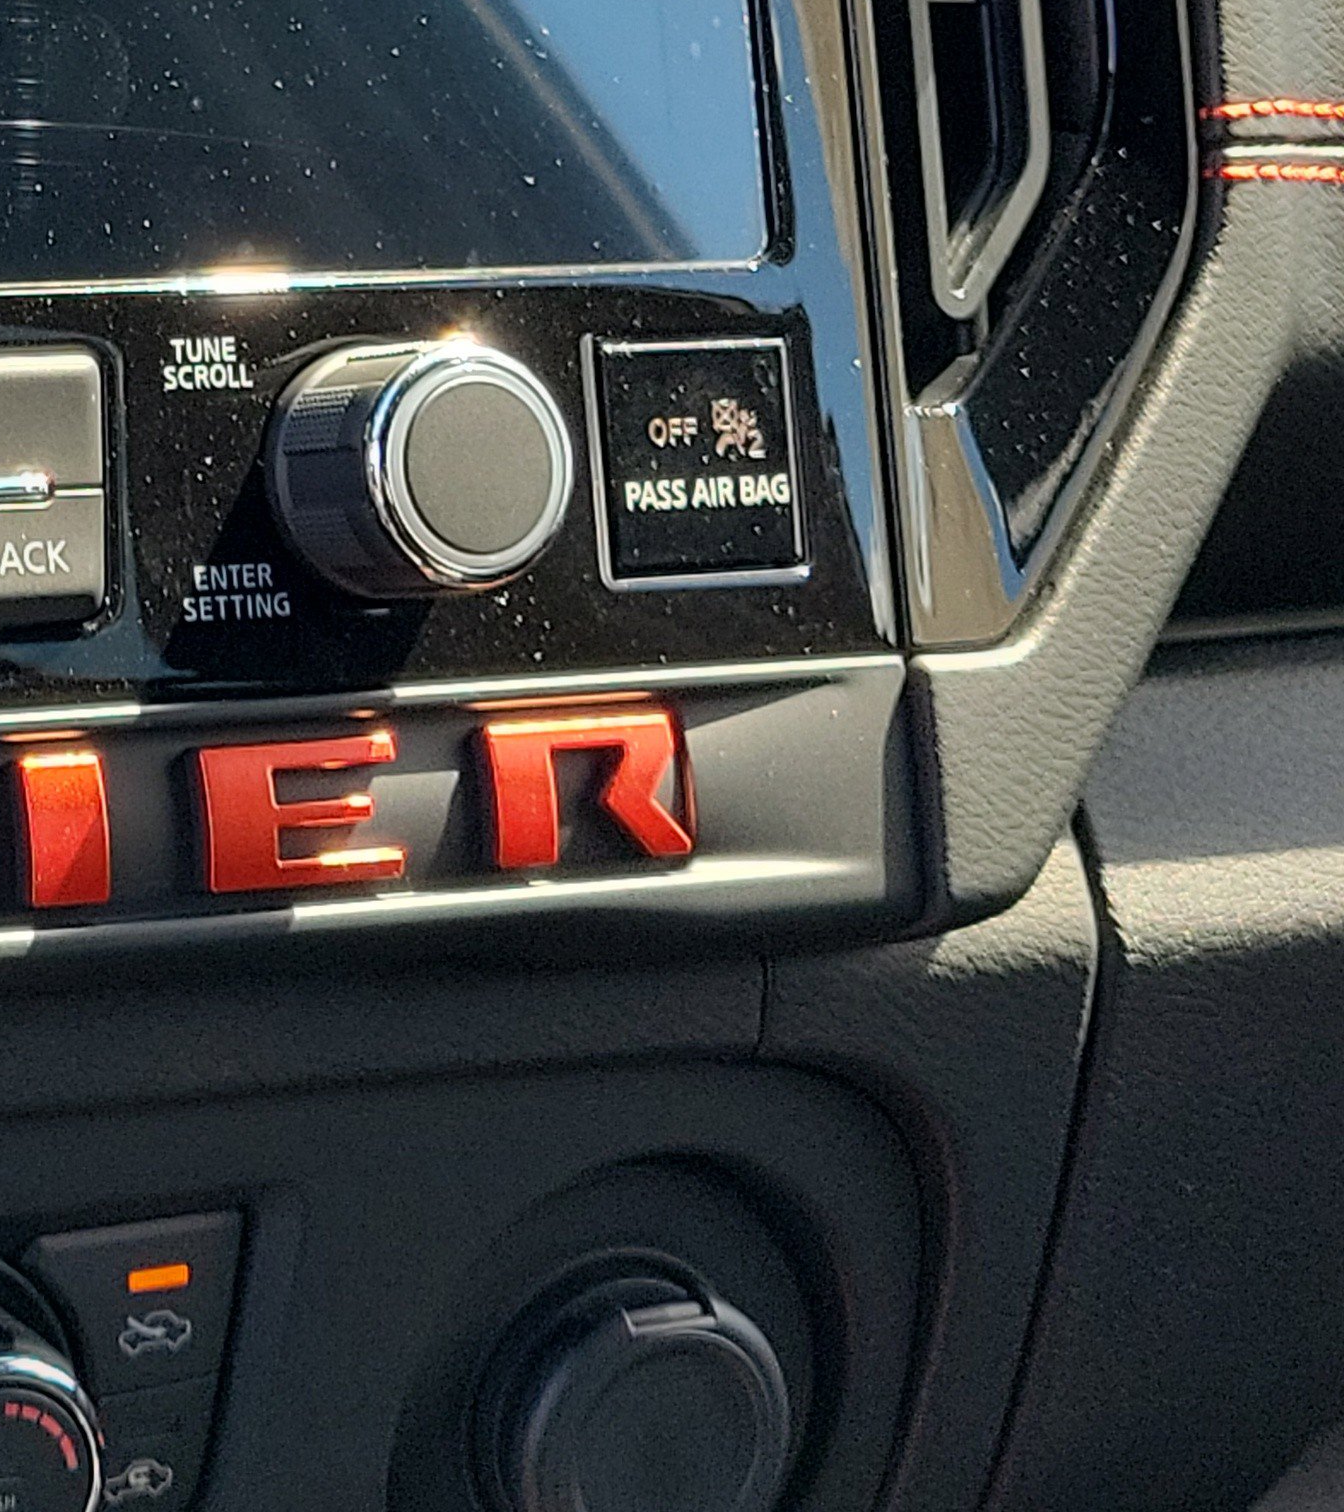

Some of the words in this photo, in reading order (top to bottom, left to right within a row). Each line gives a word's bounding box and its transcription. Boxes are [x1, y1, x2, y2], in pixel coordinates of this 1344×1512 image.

[169, 335, 237, 364] TUNE
[163, 362, 254, 390] SCROLL
[648, 417, 698, 448] OFF
[624, 478, 688, 512] PASS
[691, 475, 737, 509] AIR
[738, 472, 791, 506] BAG
[193, 563, 273, 592] ENTER
[182, 592, 291, 622] SETTING
